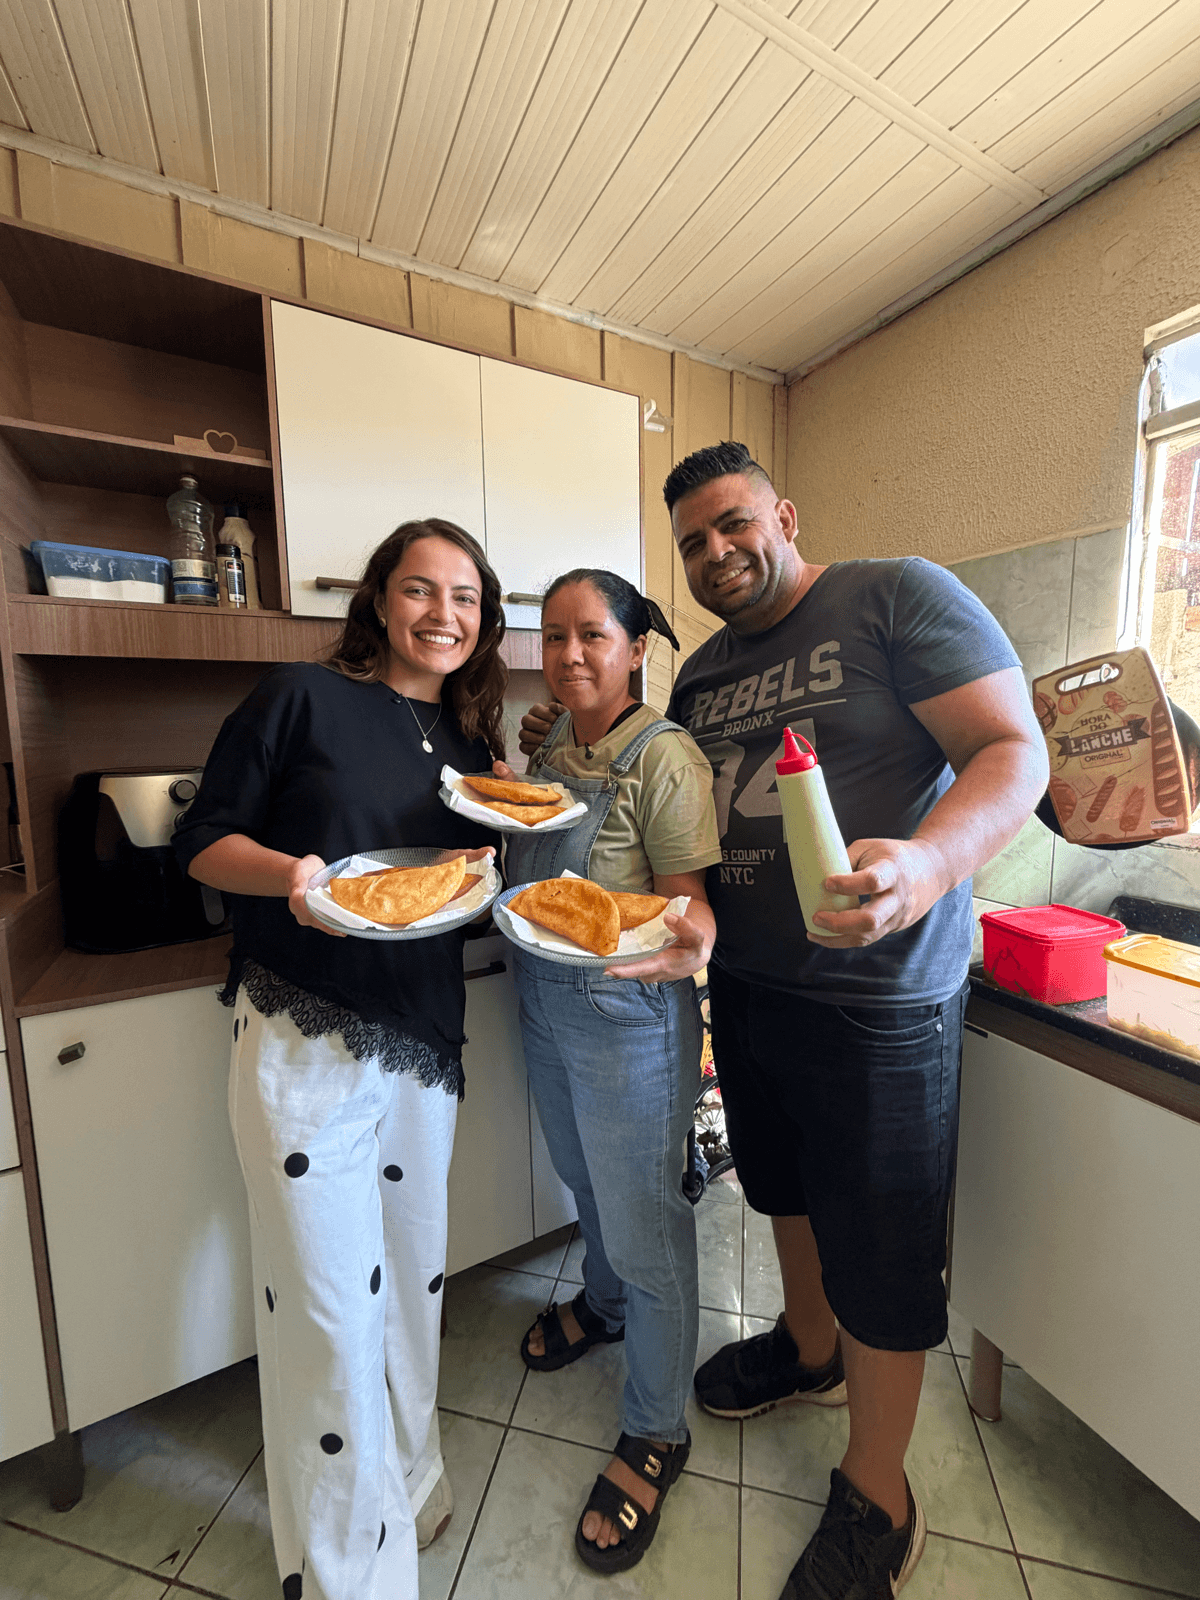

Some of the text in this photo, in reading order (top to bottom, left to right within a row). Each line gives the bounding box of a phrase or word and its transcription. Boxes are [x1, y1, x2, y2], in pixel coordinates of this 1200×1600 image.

[688, 640, 844, 731] REBELS
[721, 709, 776, 738] BRONX
[1080, 713, 1111, 727] HORA
[1089, 721, 1107, 732] DO
[1070, 728, 1133, 753] LANCHE
[730, 848, 776, 861] COUNTY
[719, 866, 755, 885] NYC
